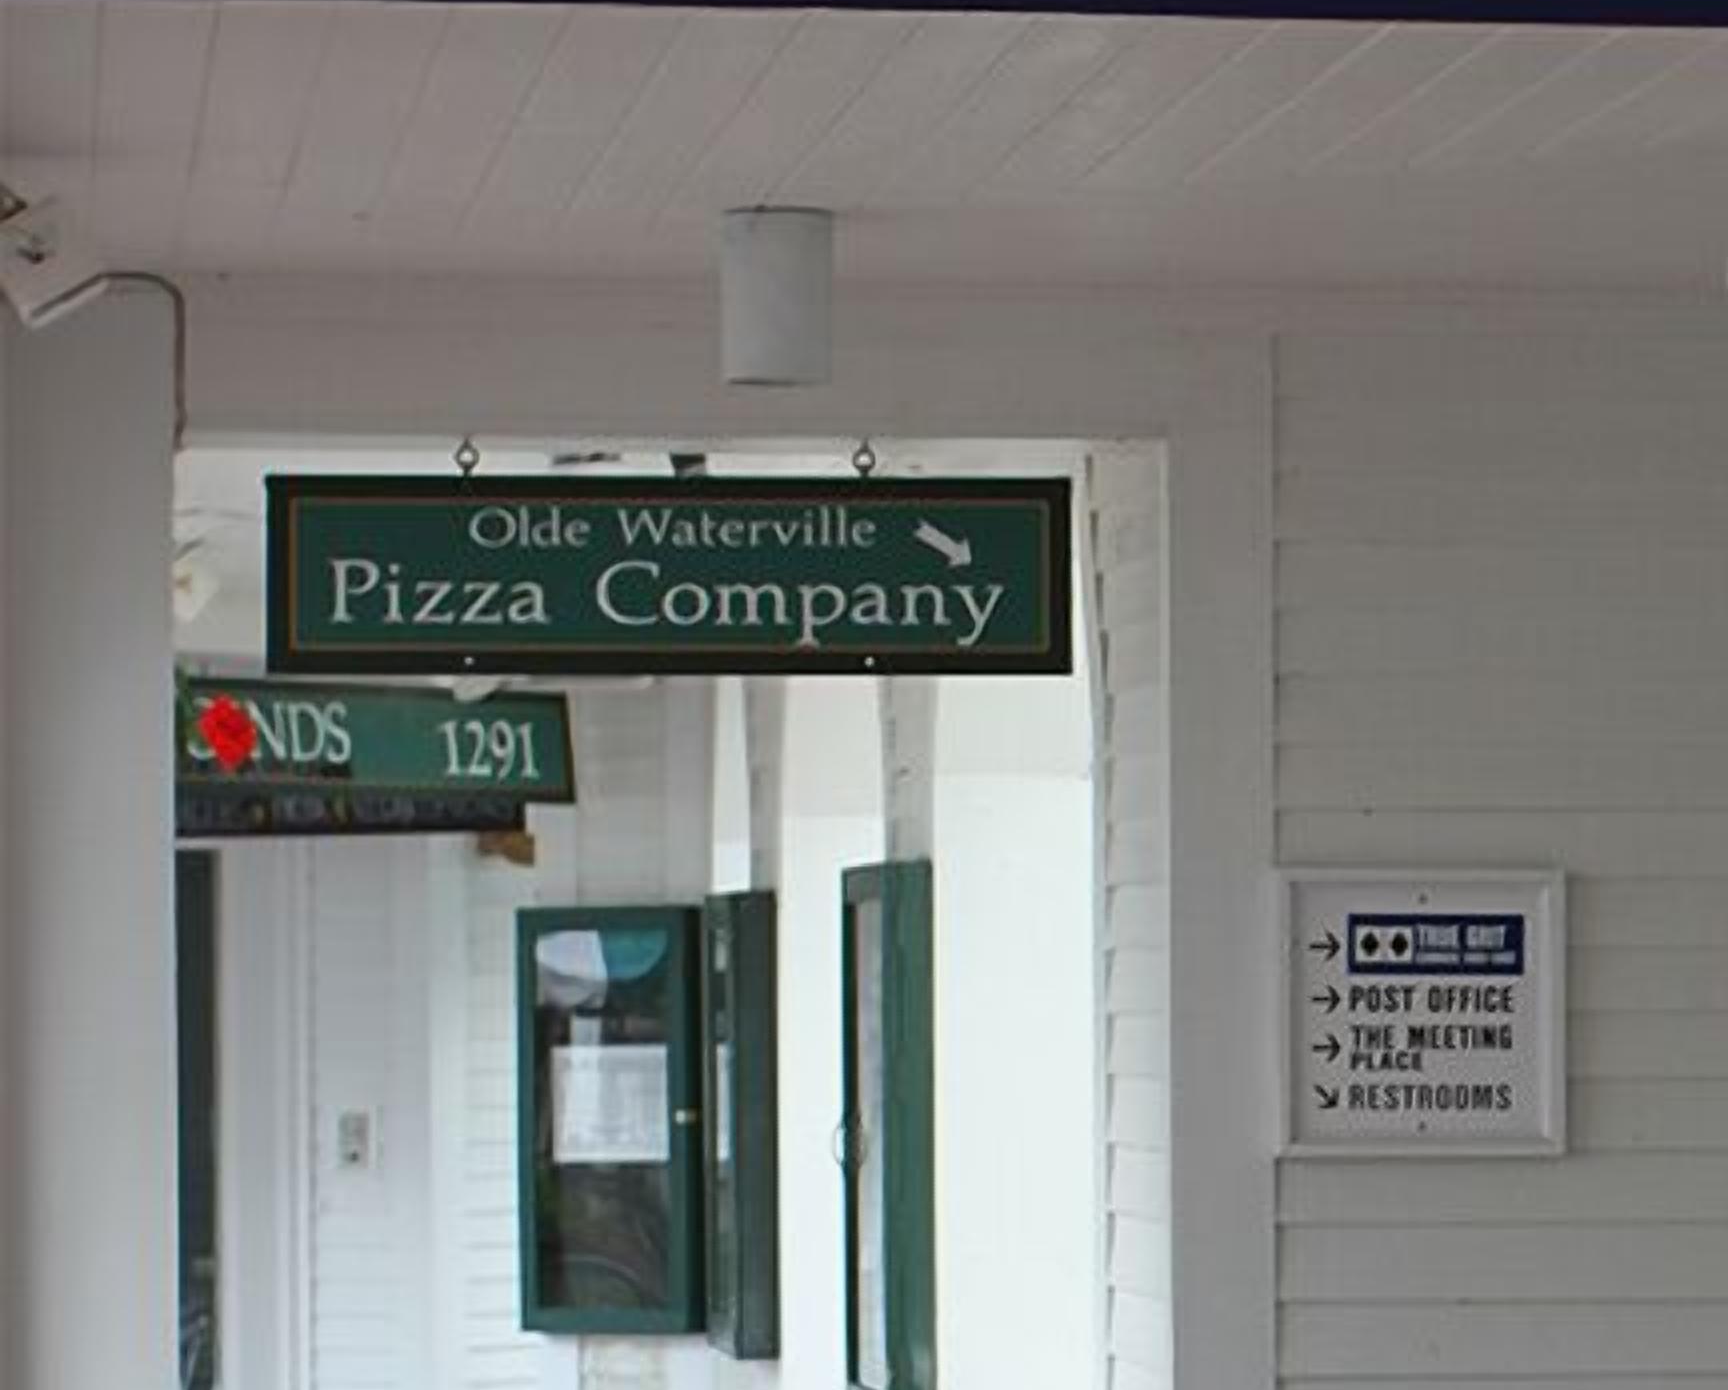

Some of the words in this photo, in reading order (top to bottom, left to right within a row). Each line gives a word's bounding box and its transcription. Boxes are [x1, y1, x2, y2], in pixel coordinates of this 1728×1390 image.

[469, 506, 590, 552] Olde
[616, 506, 878, 552] Waterville
[329, 558, 550, 625] Pizza
[595, 561, 1003, 647] Company
[438, 718, 541, 781] 1291
[1349, 985, 1415, 1013] POST
[1427, 985, 1516, 1013] OFFICE
[1351, 1024, 1396, 1049] THE
[1408, 1024, 1513, 1049] MEETING
[1350, 1051, 1423, 1071] PLACE
[1348, 1084, 1513, 1110] RESTROOMS
